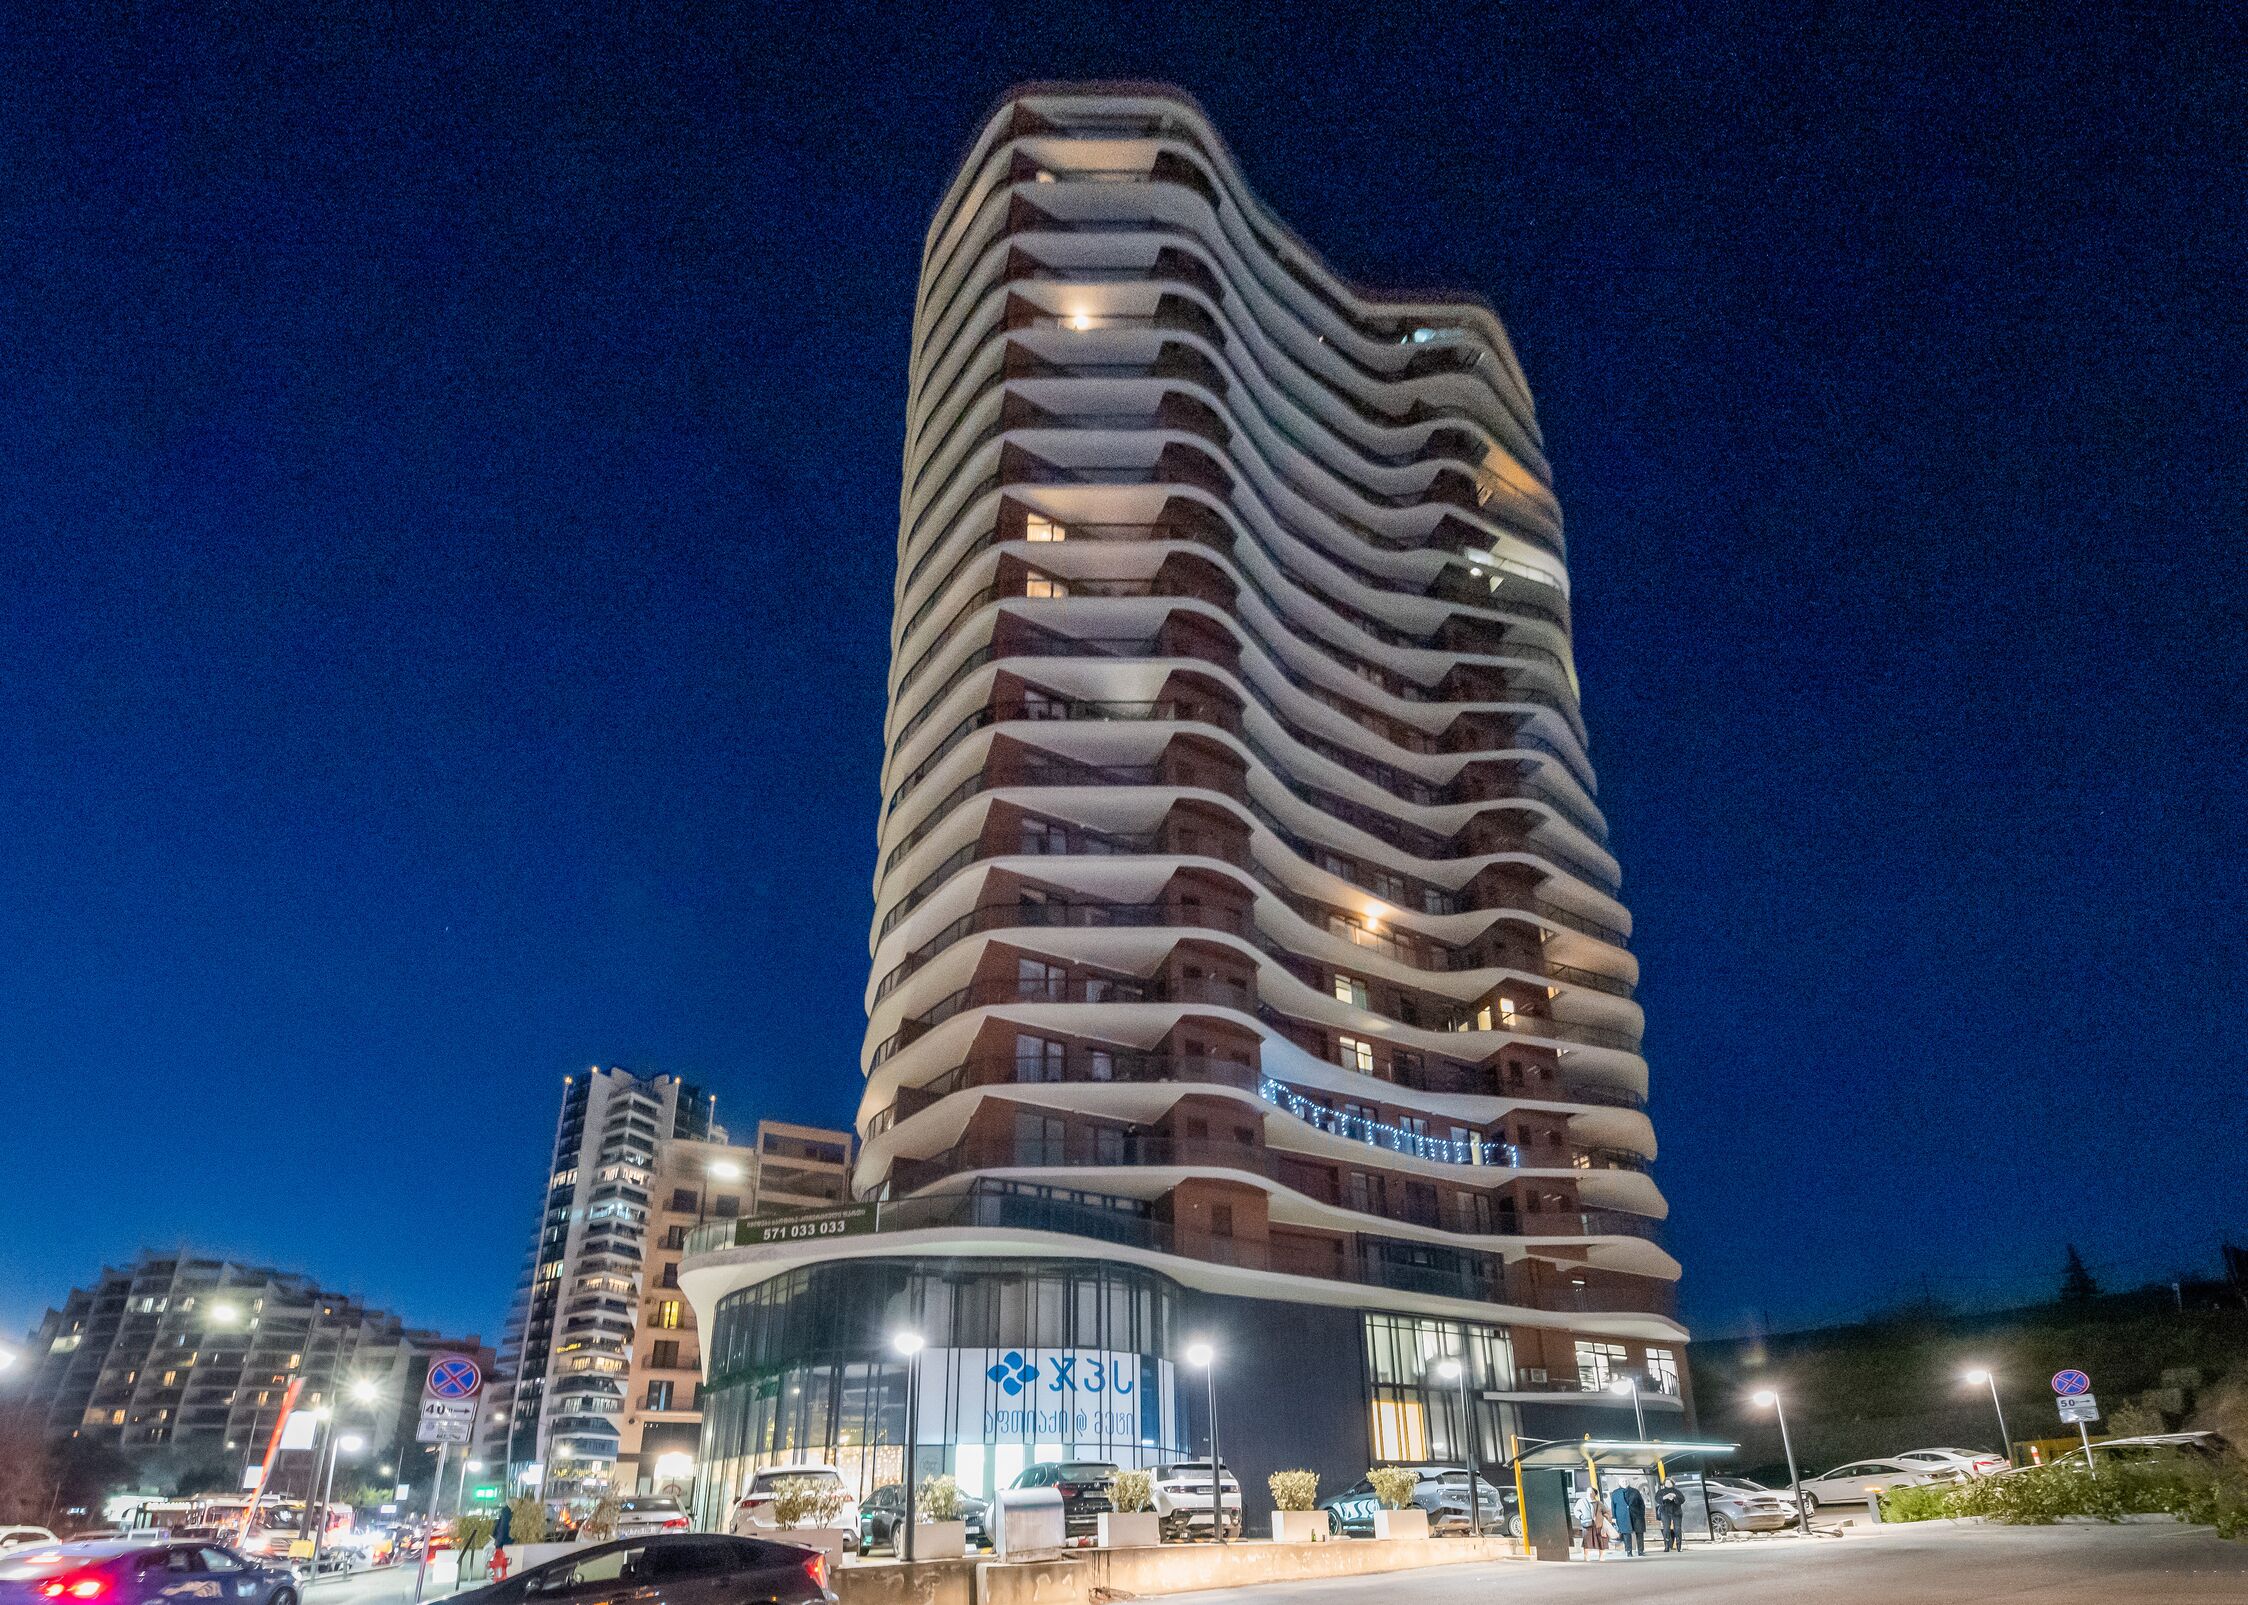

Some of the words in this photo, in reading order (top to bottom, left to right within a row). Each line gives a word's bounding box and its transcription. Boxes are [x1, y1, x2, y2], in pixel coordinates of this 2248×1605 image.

[763, 1227, 786, 1241] 571
[791, 1223, 816, 1238] 033
[820, 1220, 845, 1234] 033
[426, 1403, 445, 1415] 40
[2060, 1399, 2076, 1407] 50
